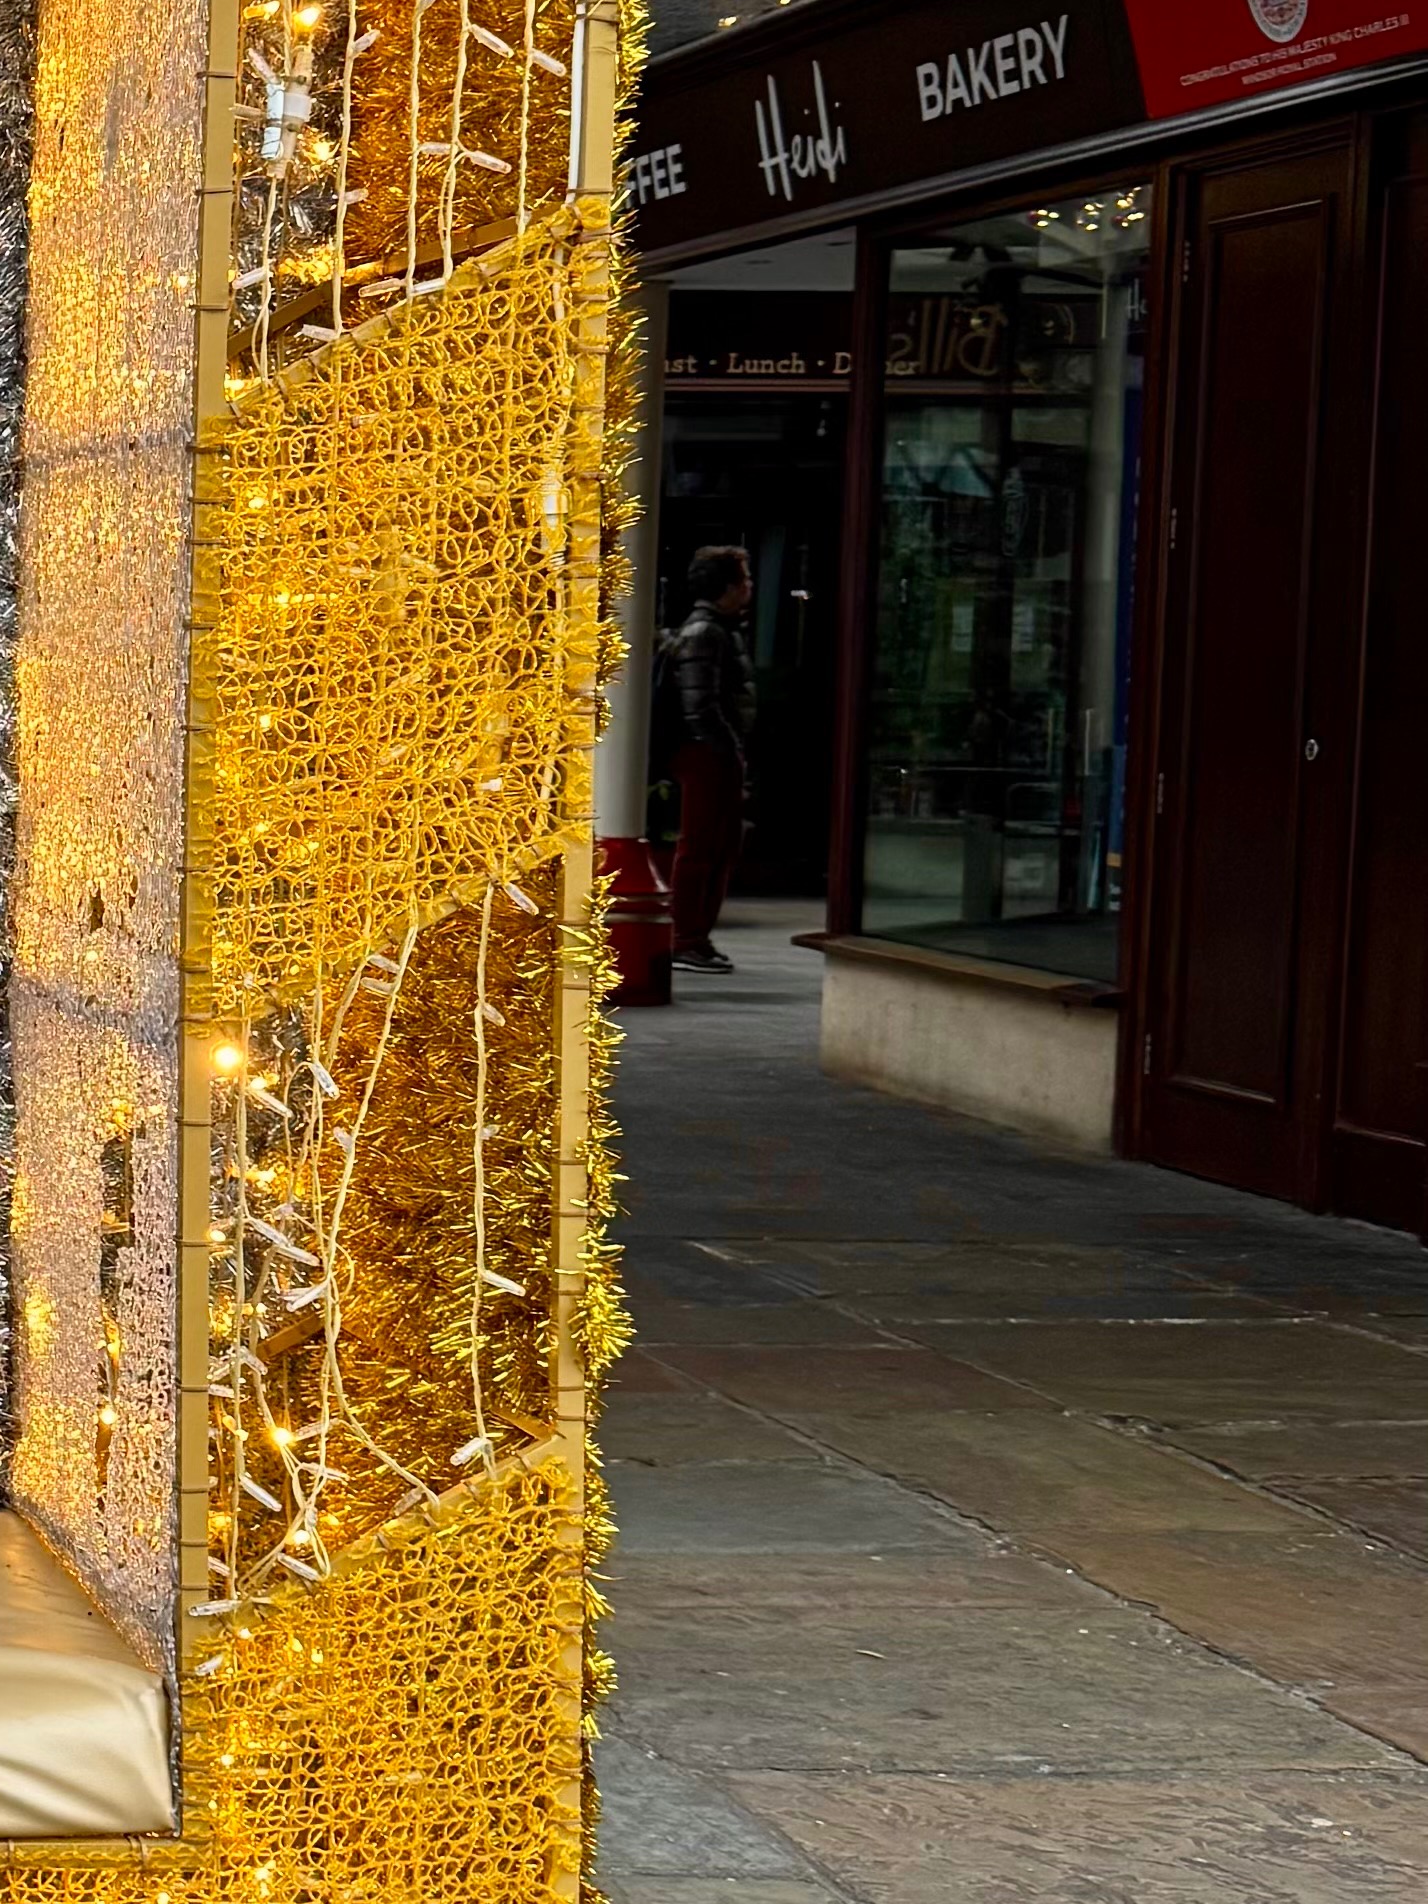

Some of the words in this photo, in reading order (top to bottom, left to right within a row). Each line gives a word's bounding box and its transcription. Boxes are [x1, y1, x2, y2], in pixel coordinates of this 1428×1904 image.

[1353, 14, 1400, 40] CHARLES
[916, 14, 1069, 122] BAKERY
[754, 59, 848, 202] Heidi
[725, 351, 807, 375] Lunch
